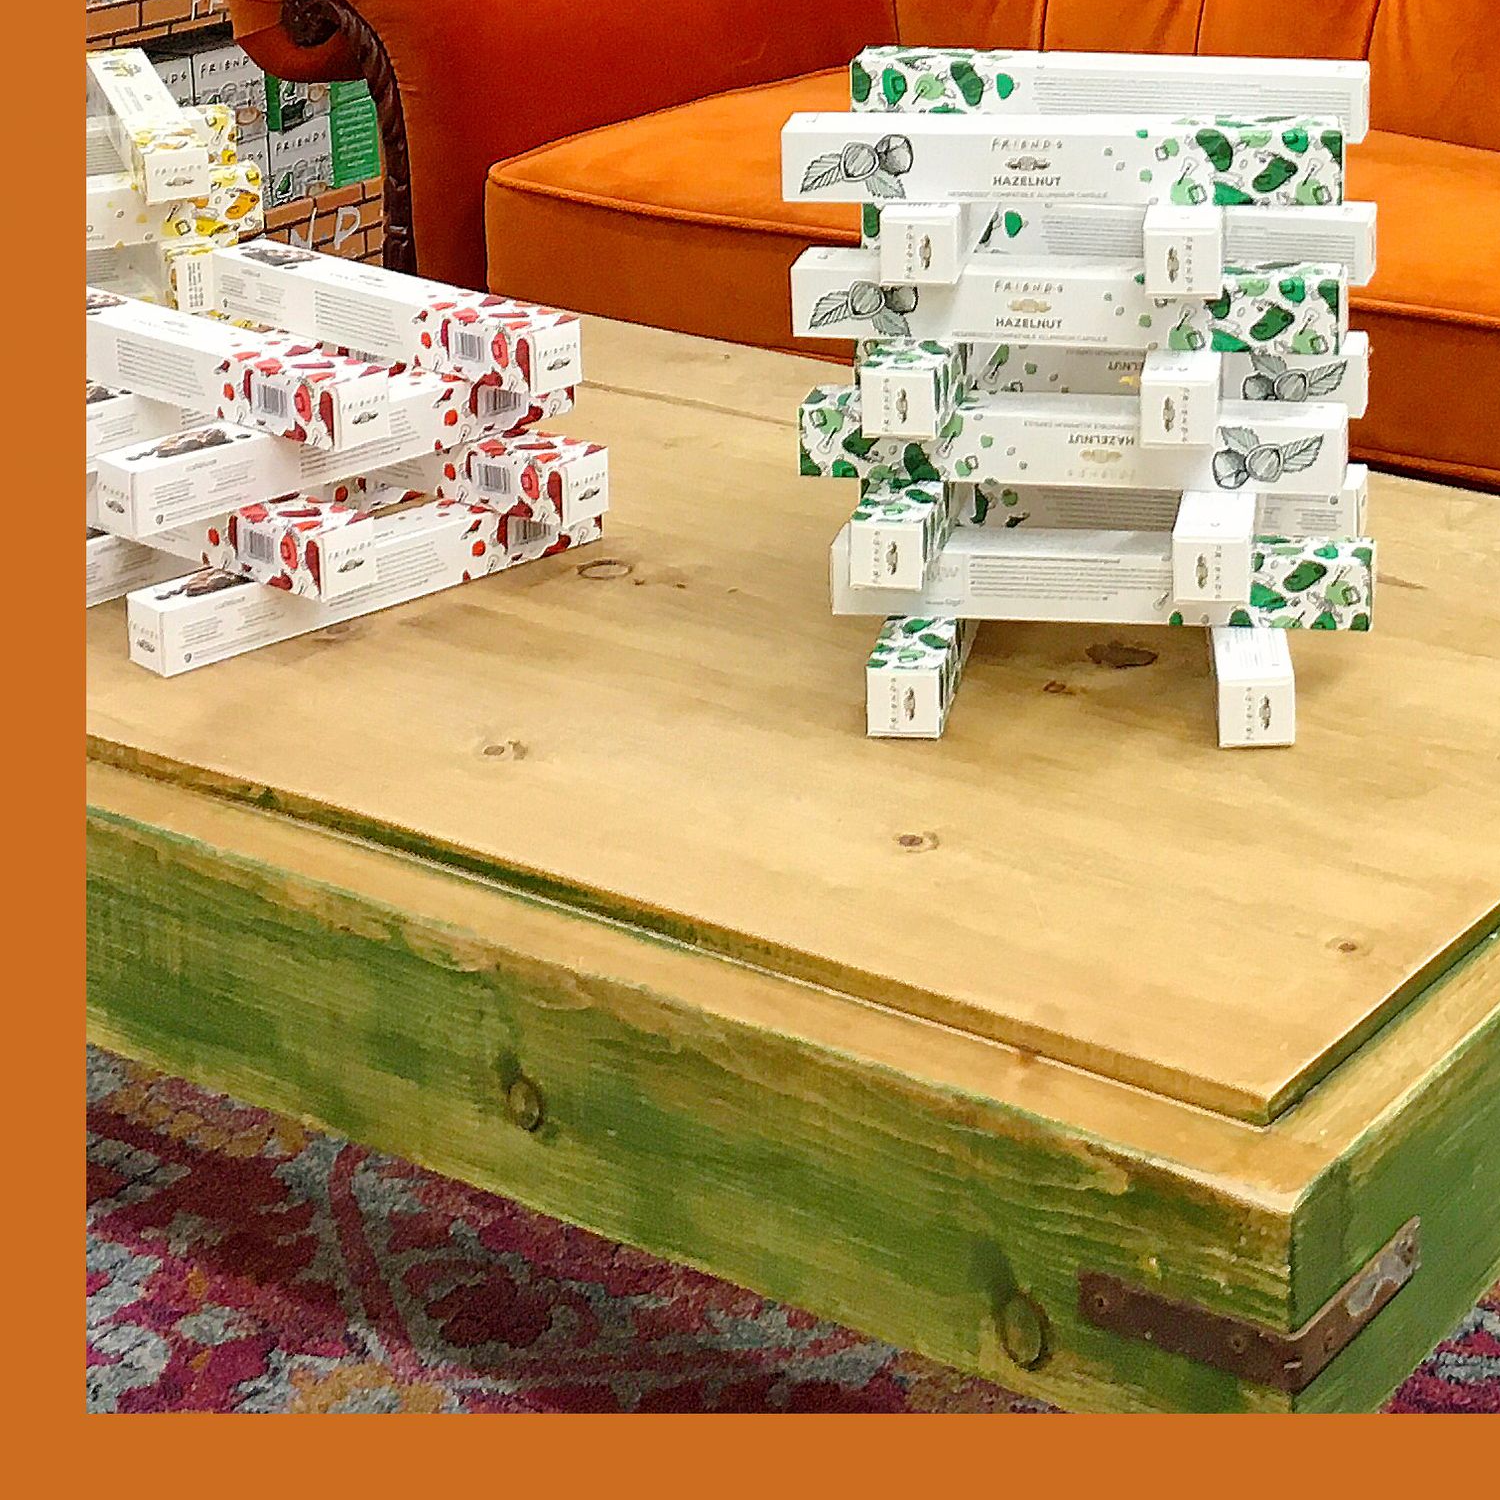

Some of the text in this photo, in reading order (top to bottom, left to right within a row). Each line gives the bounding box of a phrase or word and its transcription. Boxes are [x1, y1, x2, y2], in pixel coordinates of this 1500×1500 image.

[201, 55, 250, 76] FRIEND
[275, 130, 326, 156] FRIENDS
[992, 176, 1062, 187] HAZELNUT
[995, 317, 1063, 329] HAZELNUT
